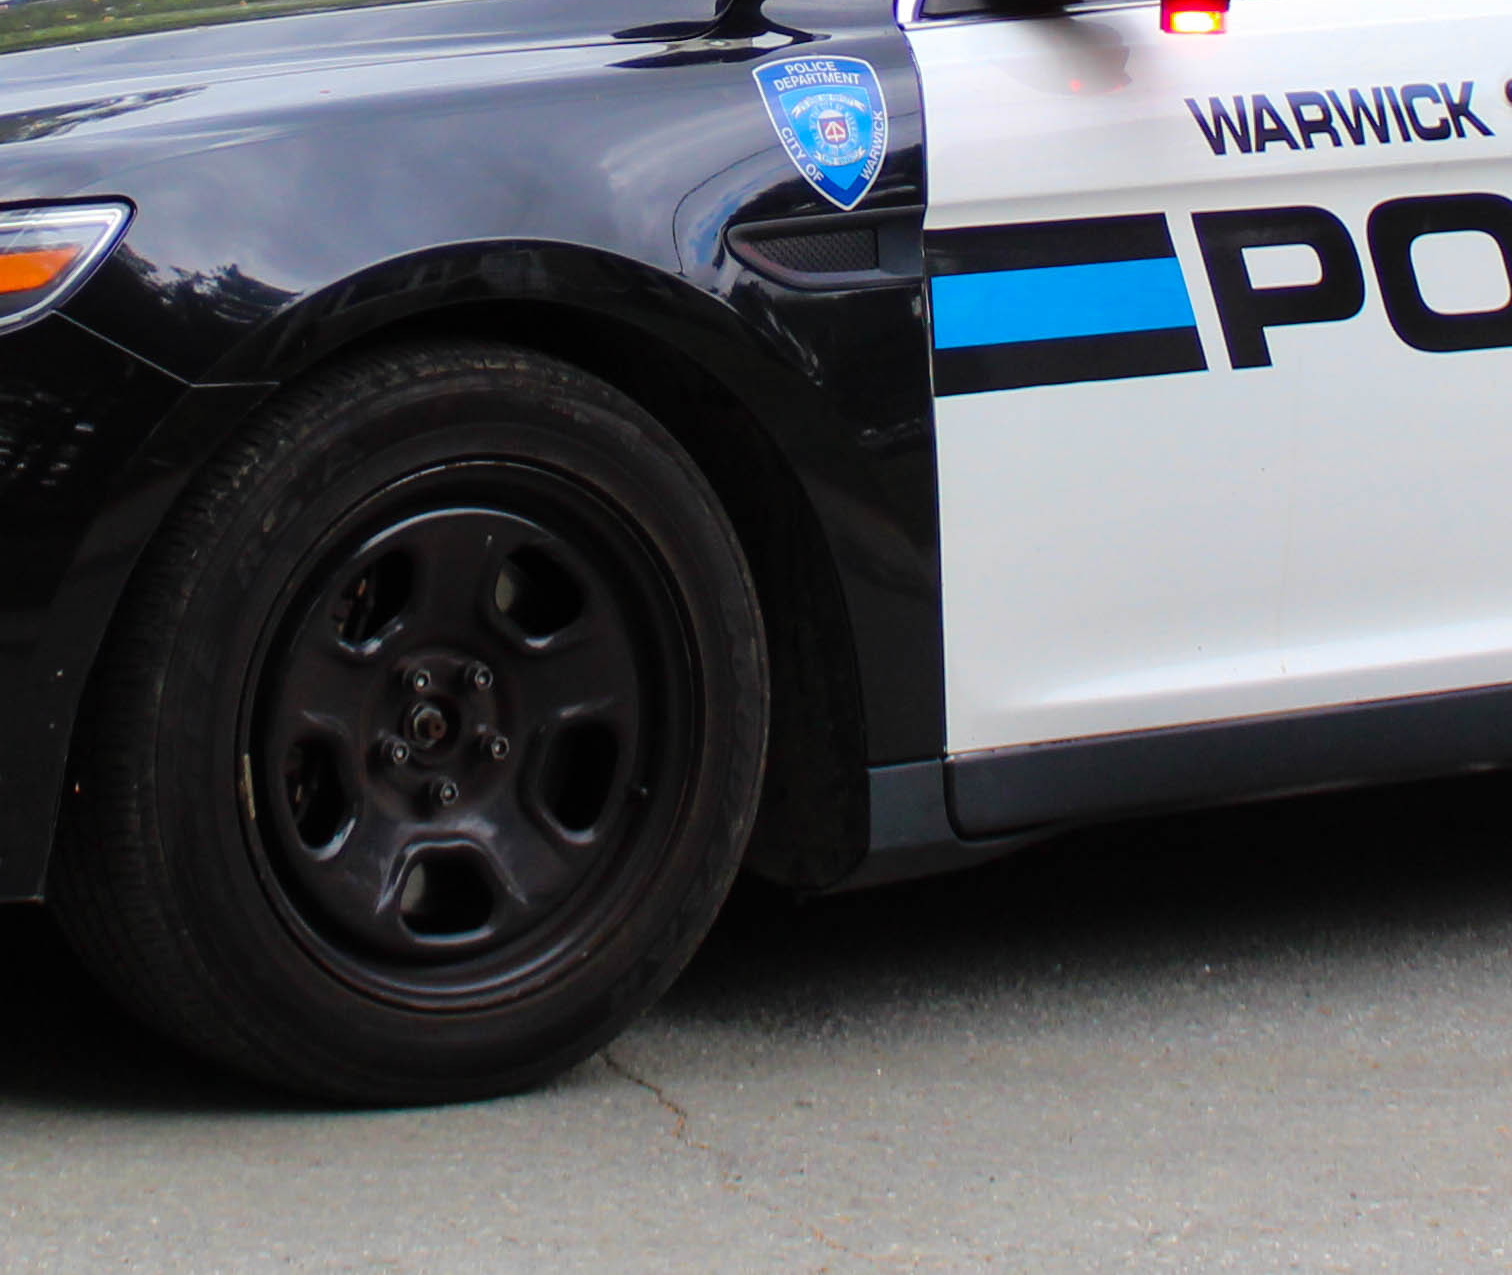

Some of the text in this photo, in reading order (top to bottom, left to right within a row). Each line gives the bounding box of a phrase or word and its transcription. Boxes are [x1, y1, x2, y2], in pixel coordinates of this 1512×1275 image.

[773, 72, 860, 91] DEPARTMENT
[784, 61, 837, 74] POLICE
[860, 110, 883, 180] WARWICK
[1184, 80, 1496, 157] WARWICK
[781, 127, 824, 182] CITY OF
